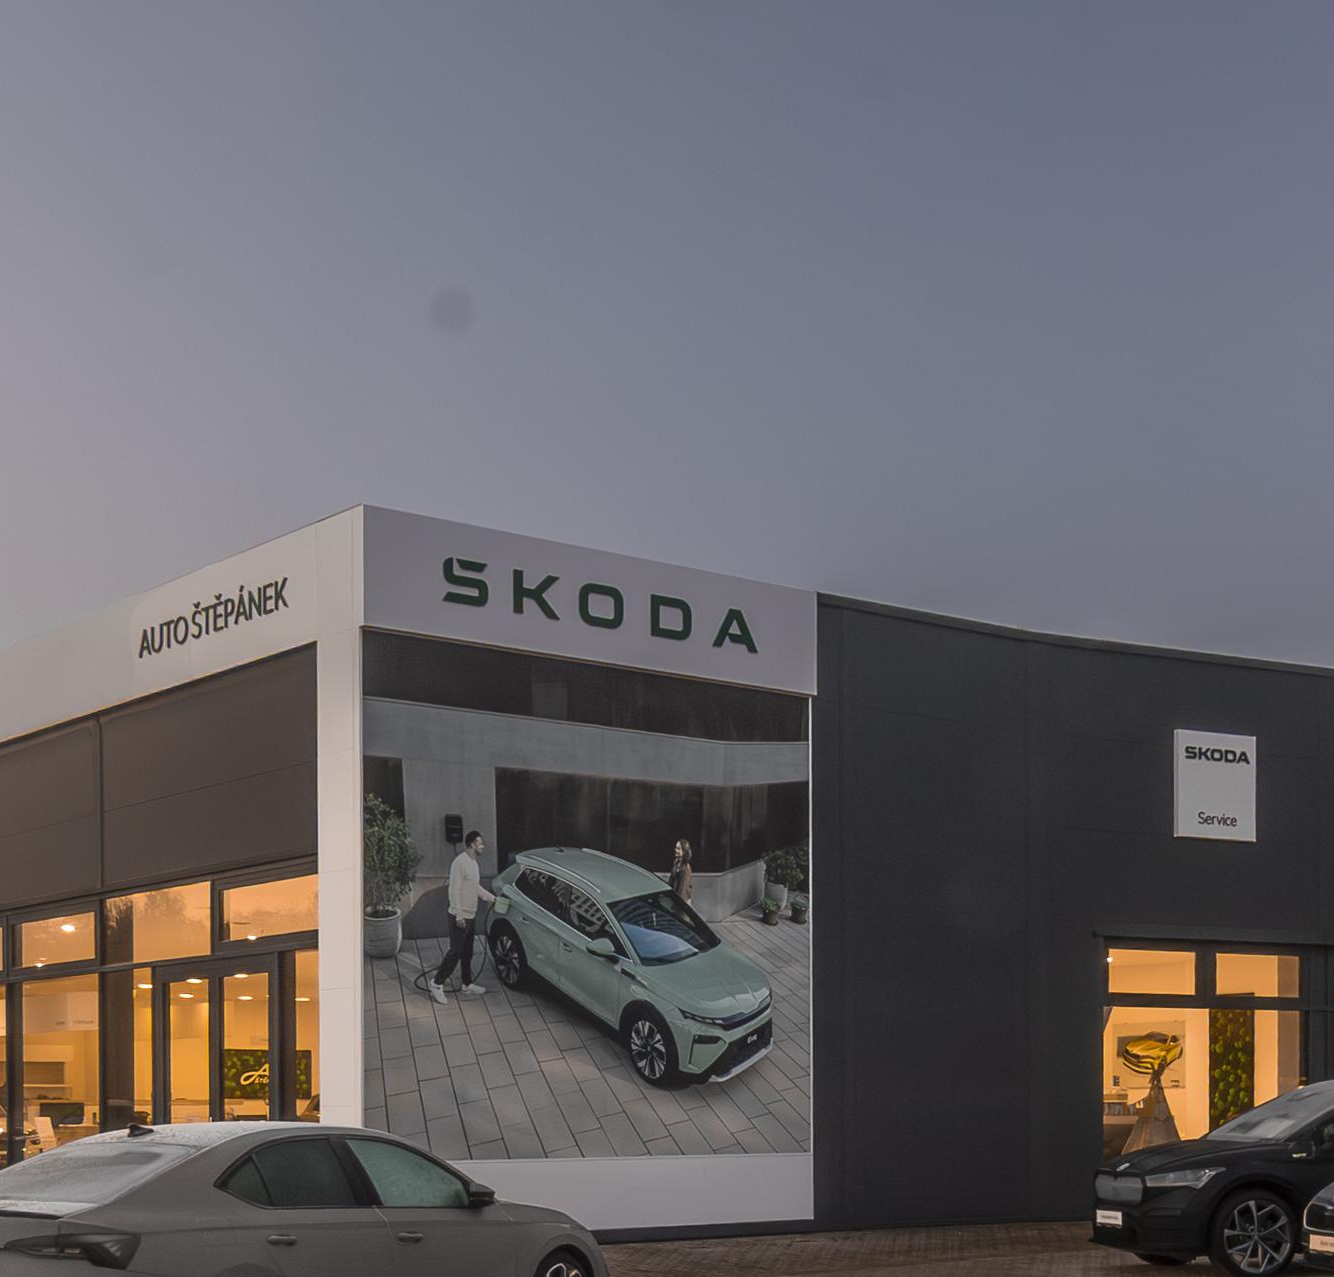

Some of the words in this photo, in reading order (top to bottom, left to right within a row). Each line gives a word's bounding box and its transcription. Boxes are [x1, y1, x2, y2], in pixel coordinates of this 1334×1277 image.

[138, 615, 189, 659] AUTO
[191, 576, 289, 640] ŠTĚPÁNEK
[1197, 811, 1238, 828] Service
